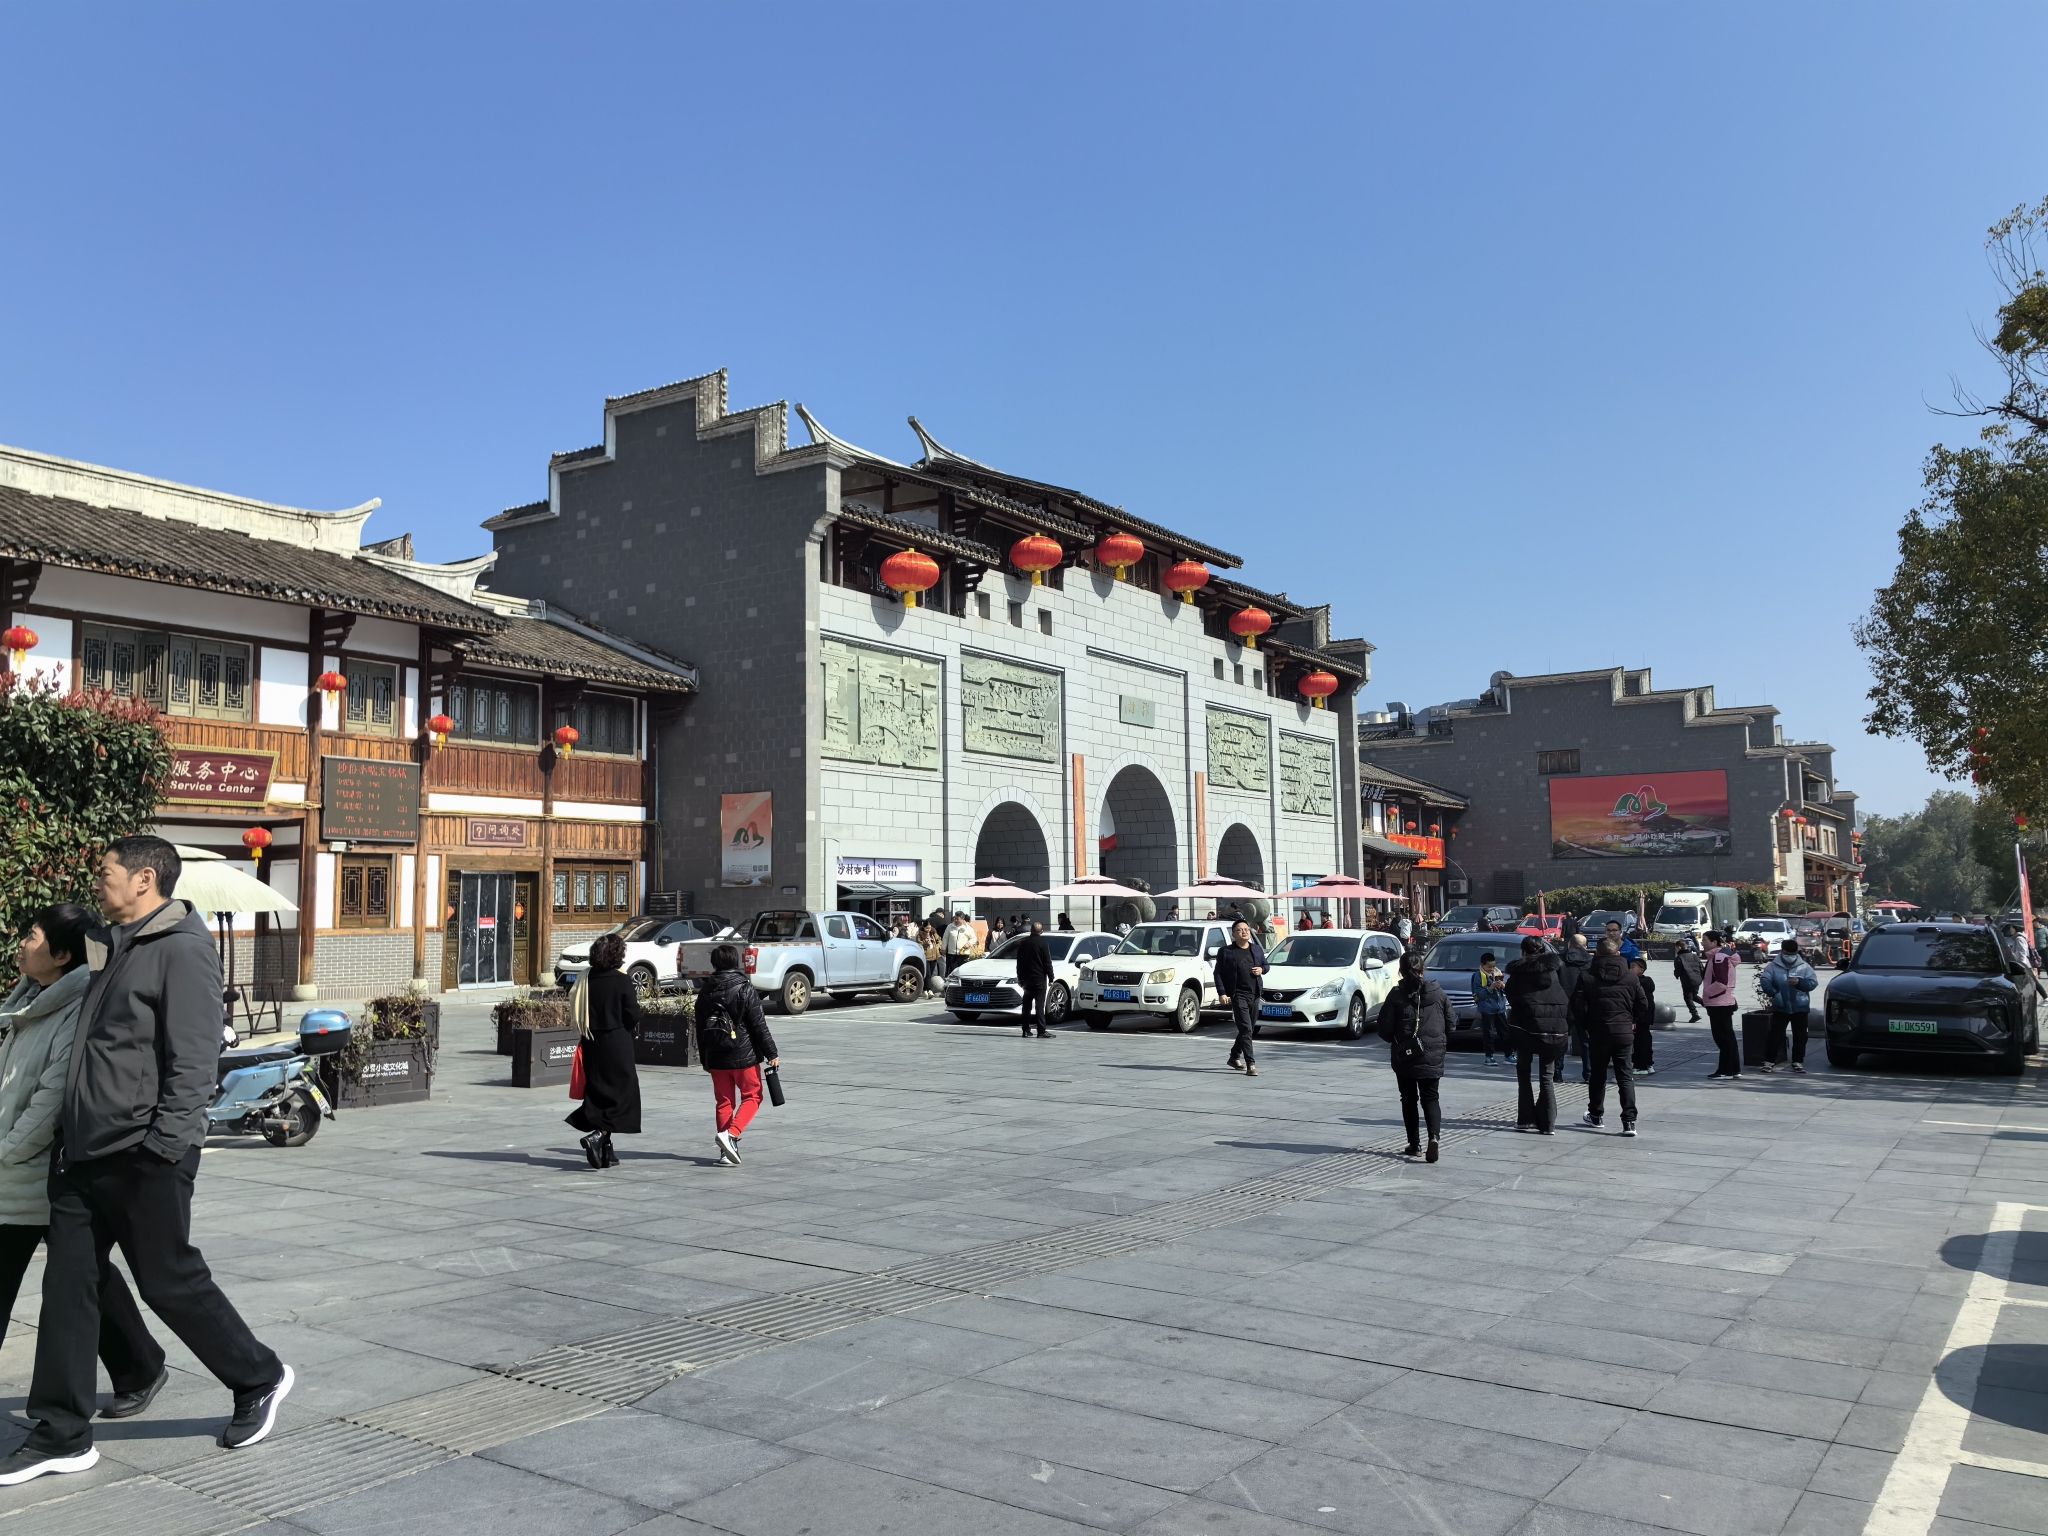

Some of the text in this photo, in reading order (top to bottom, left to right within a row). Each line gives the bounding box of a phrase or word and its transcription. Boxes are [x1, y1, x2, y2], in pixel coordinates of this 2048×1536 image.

[172, 760, 259, 783] 服务中心
[170, 780, 256, 794] Service Center
[488, 823, 521, 837] 问询处
[837, 863, 871, 876] 沙村咖啡
